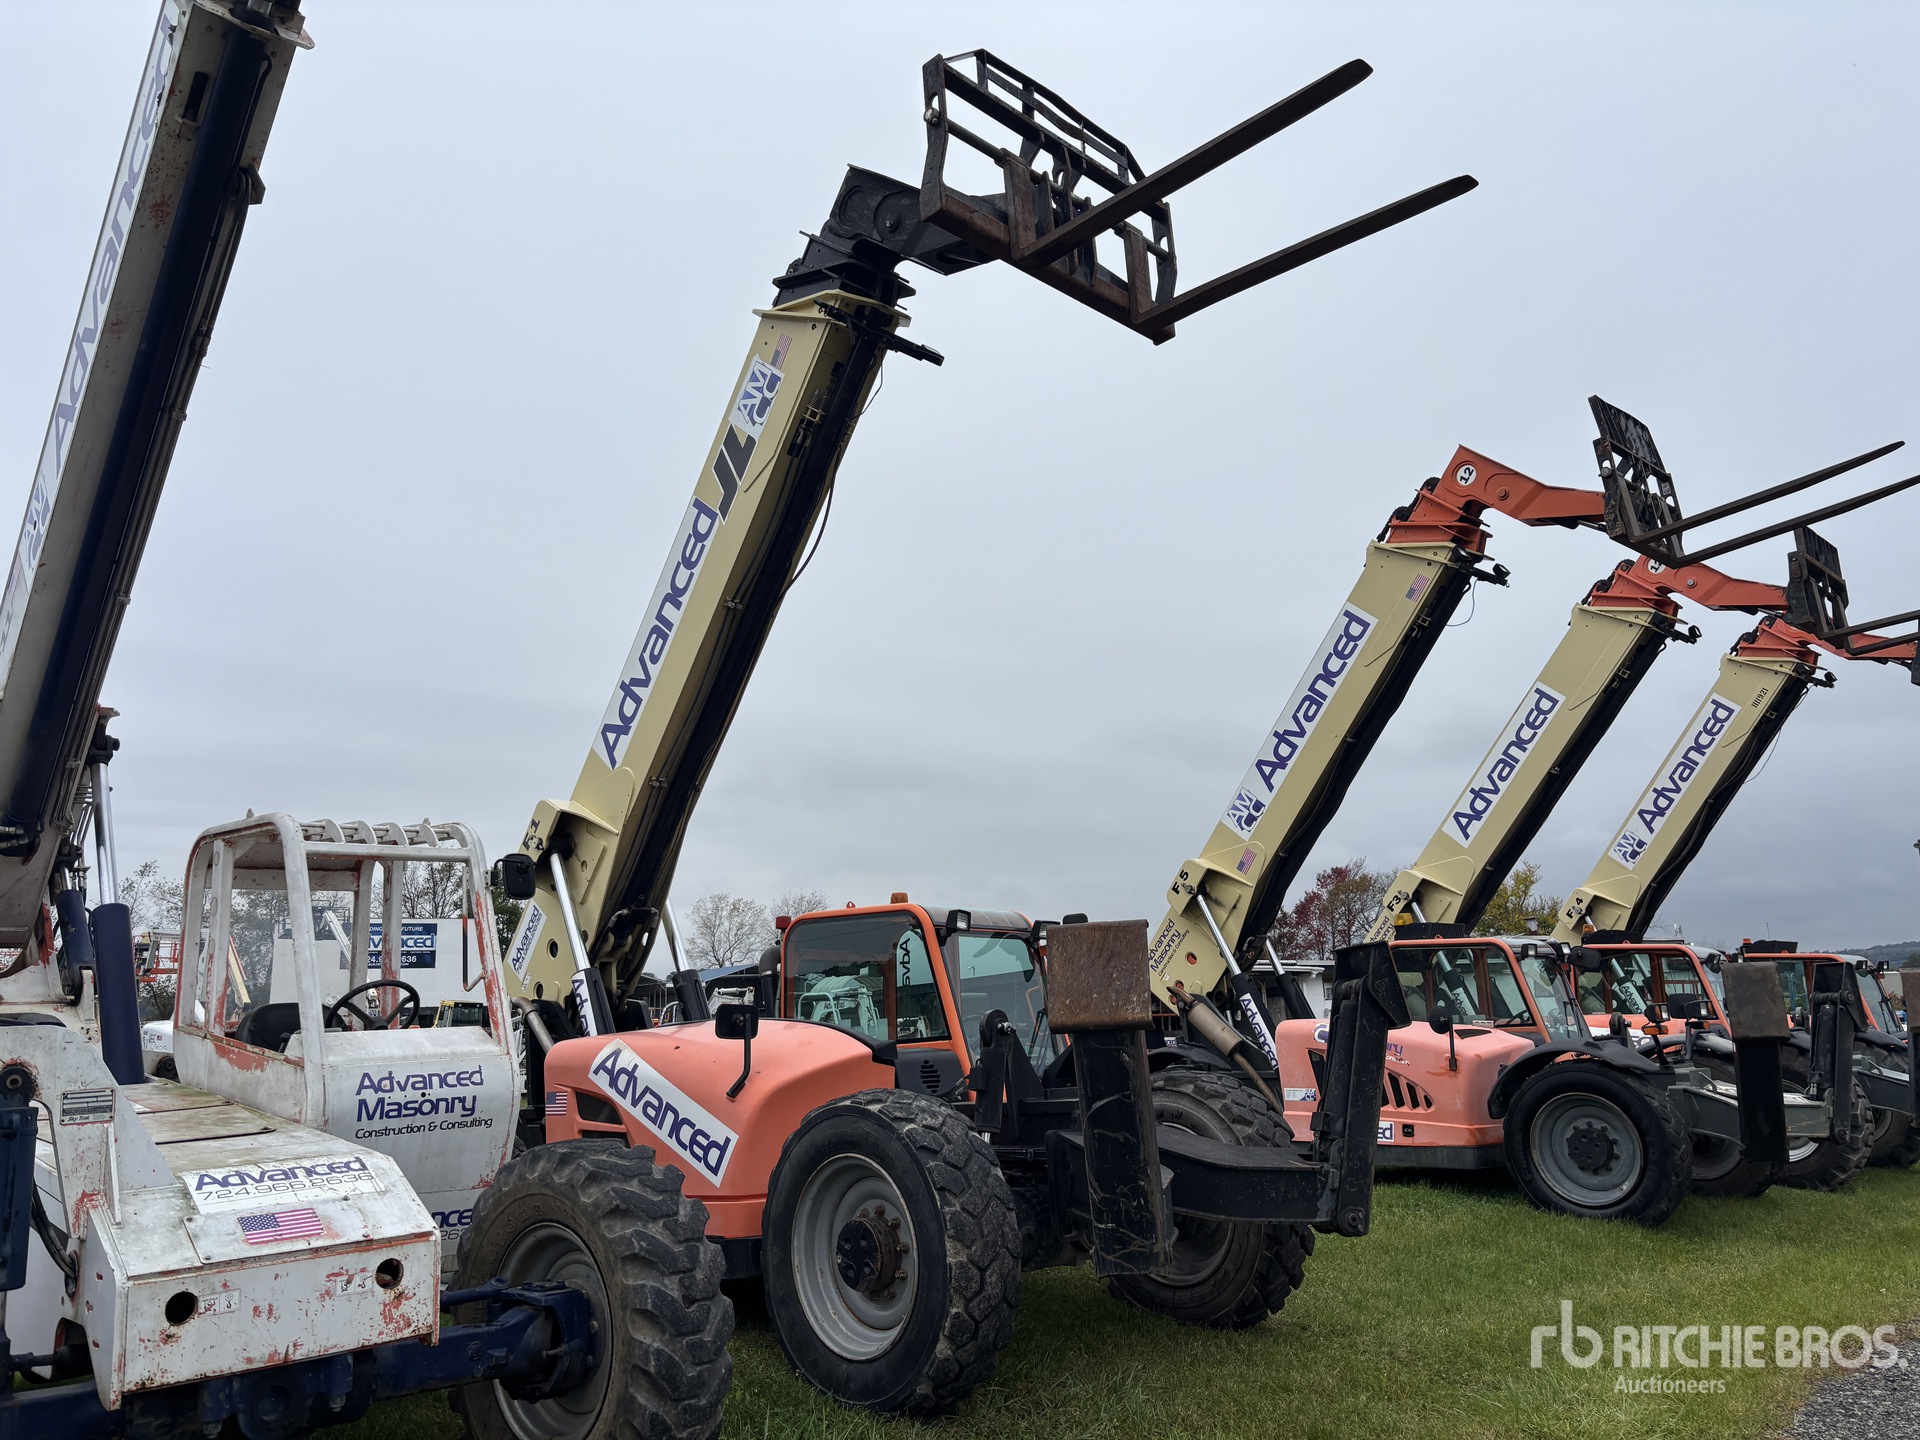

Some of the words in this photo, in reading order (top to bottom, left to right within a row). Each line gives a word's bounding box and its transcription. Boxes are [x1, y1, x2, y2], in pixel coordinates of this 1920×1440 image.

[55, 12, 175, 478] Advanced
[1460, 467, 1474, 484] 12
[601, 497, 719, 770] Advanced
[1255, 610, 1371, 793] Advanced
[1453, 688, 1559, 841] Advanced
[1637, 699, 1735, 834] Advanced
[512, 905, 539, 971] Advanced
[1148, 918, 1175, 960] dvanced
[1150, 929, 1182, 972] Masonry
[356, 1065, 483, 1095] Advanced
[355, 1123, 425, 1139] Construction
[428, 1122, 438, 1131] &
[439, 1117, 493, 1132] Consulting
[356, 1095, 477, 1121] Masonry
[593, 1048, 732, 1177] Advanced
[195, 1157, 369, 1191] Advanced
[197, 1173, 374, 1200] 724.966.2636
